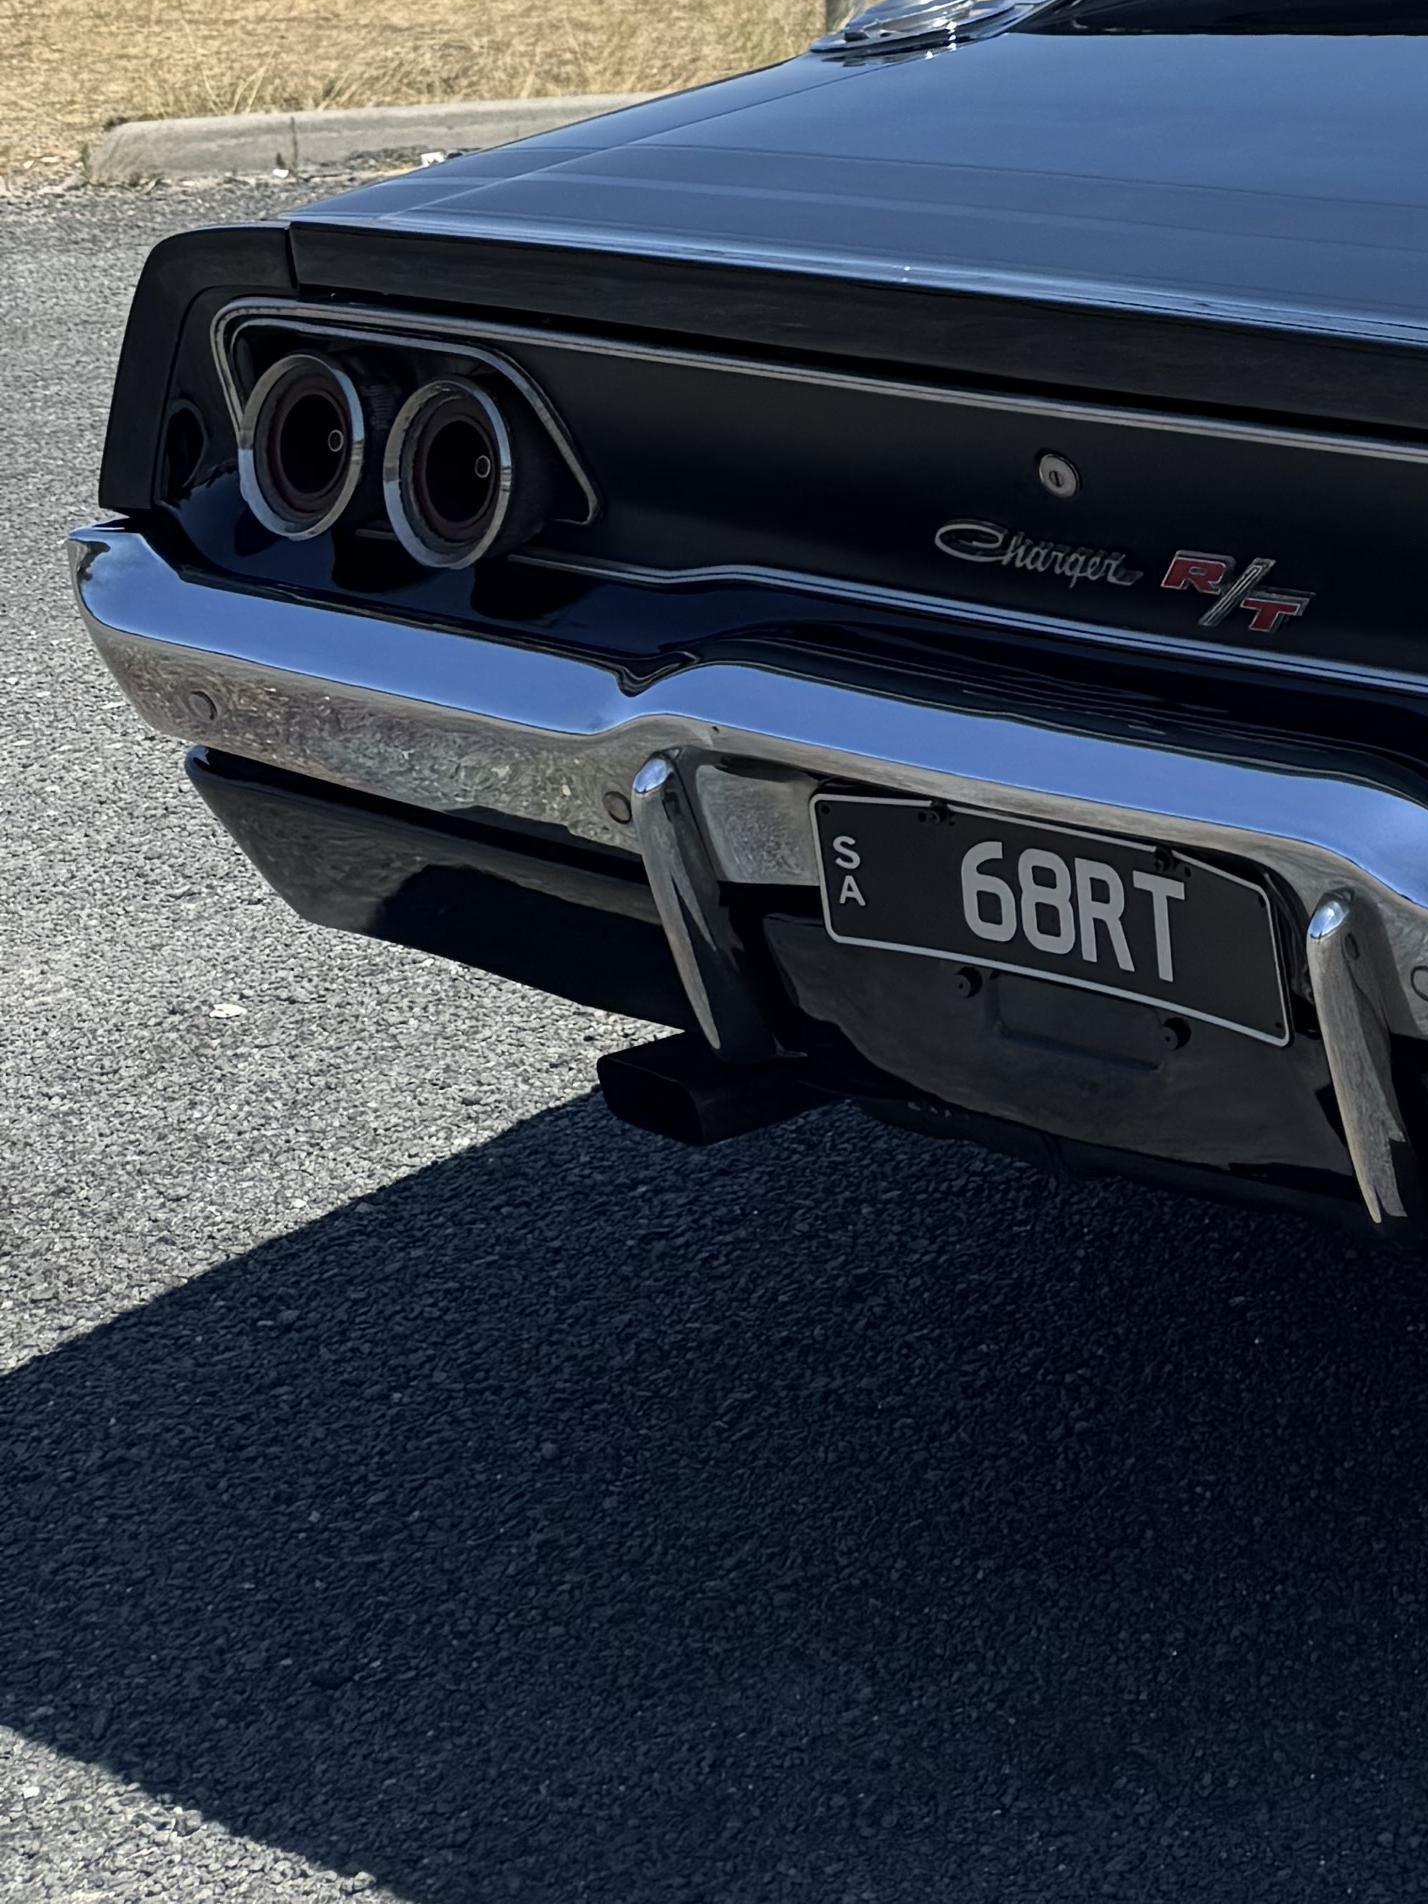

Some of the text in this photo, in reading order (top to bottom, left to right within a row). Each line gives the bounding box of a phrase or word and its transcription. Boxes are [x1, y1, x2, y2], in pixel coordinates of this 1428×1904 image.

[935, 521, 1312, 633] Charger R/T
[960, 840, 1186, 983] 68RT
